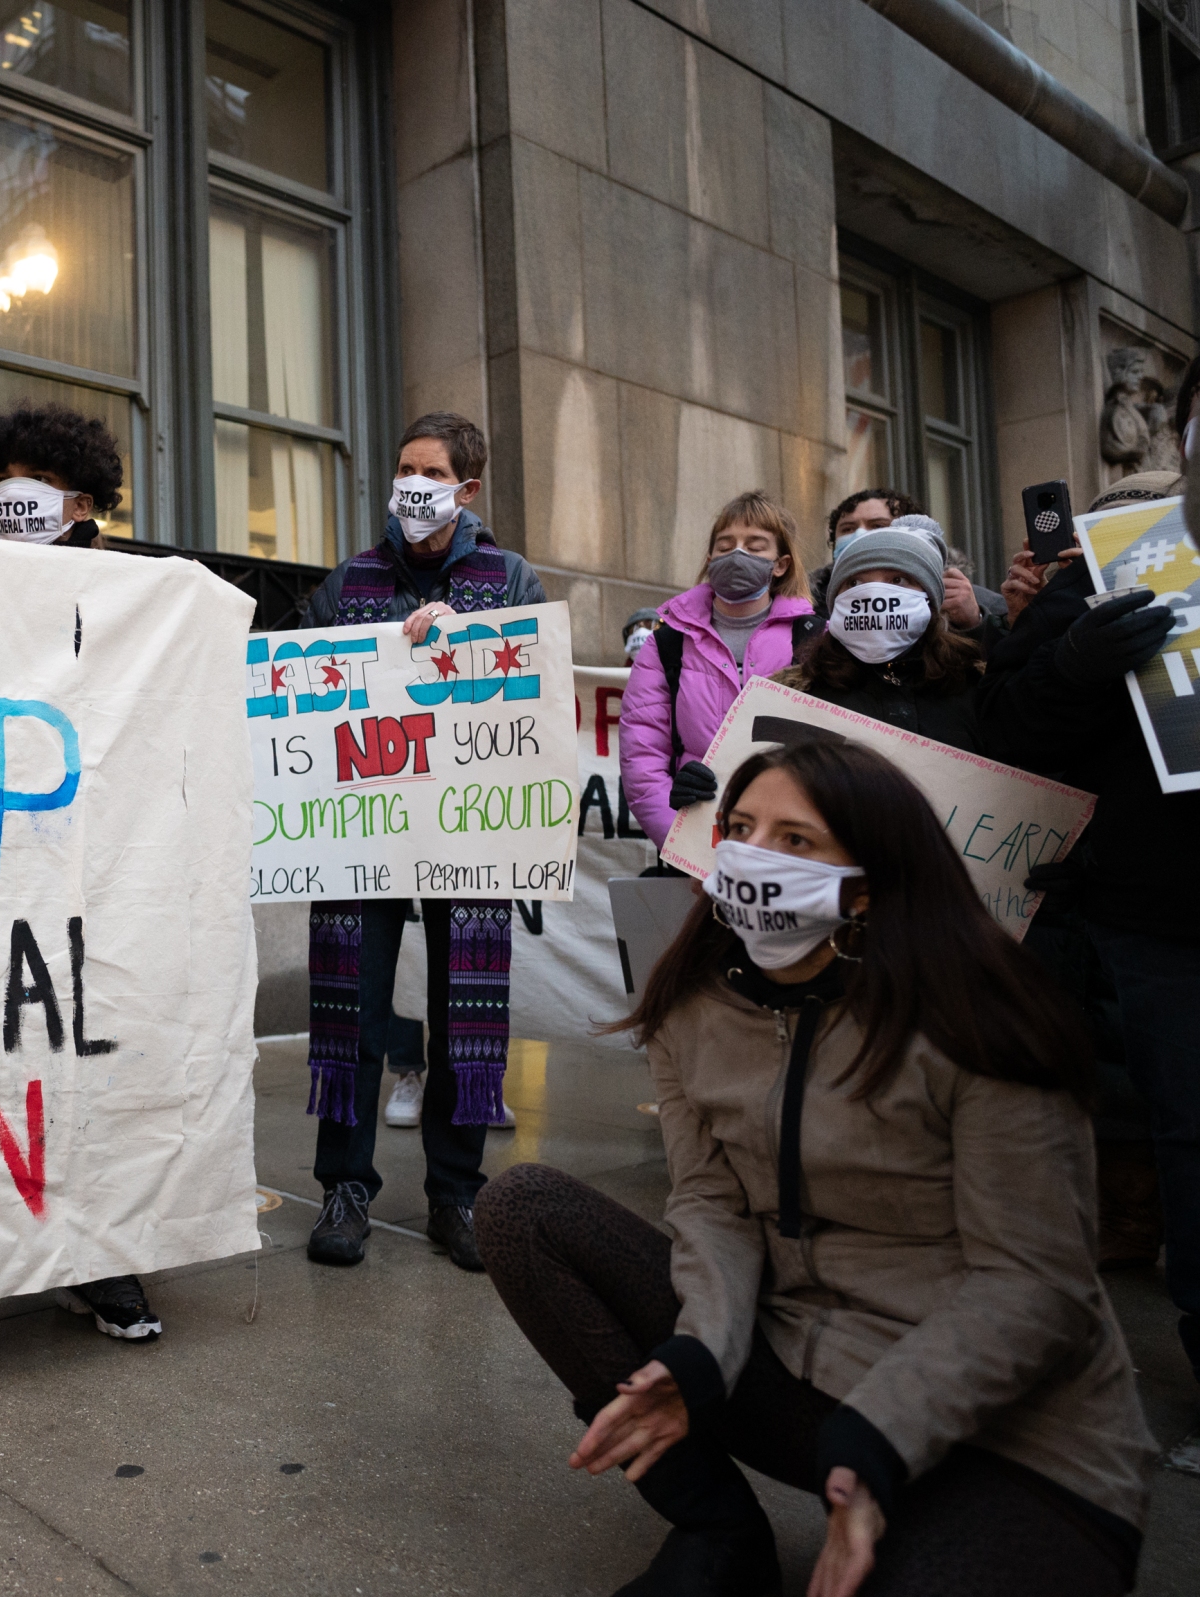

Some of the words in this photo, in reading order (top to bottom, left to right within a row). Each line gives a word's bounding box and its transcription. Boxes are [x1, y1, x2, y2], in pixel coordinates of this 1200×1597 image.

[399, 490, 433, 505] STOP
[418, 506, 436, 519] IRON
[25, 517, 46, 533] IRON
[850, 597, 901, 614] STOP
[843, 615, 883, 631] GENERAL
[885, 614, 908, 630] IRON
[247, 637, 379, 719] EAST
[405, 618, 540, 706] SIDE
[271, 735, 313, 776] IS
[334, 712, 436, 782] NOT
[454, 716, 539, 766] YOUR
[512, 860, 573, 891] LORI!
[716, 870, 783, 907] STOP
[757, 910, 799, 932] IRON
